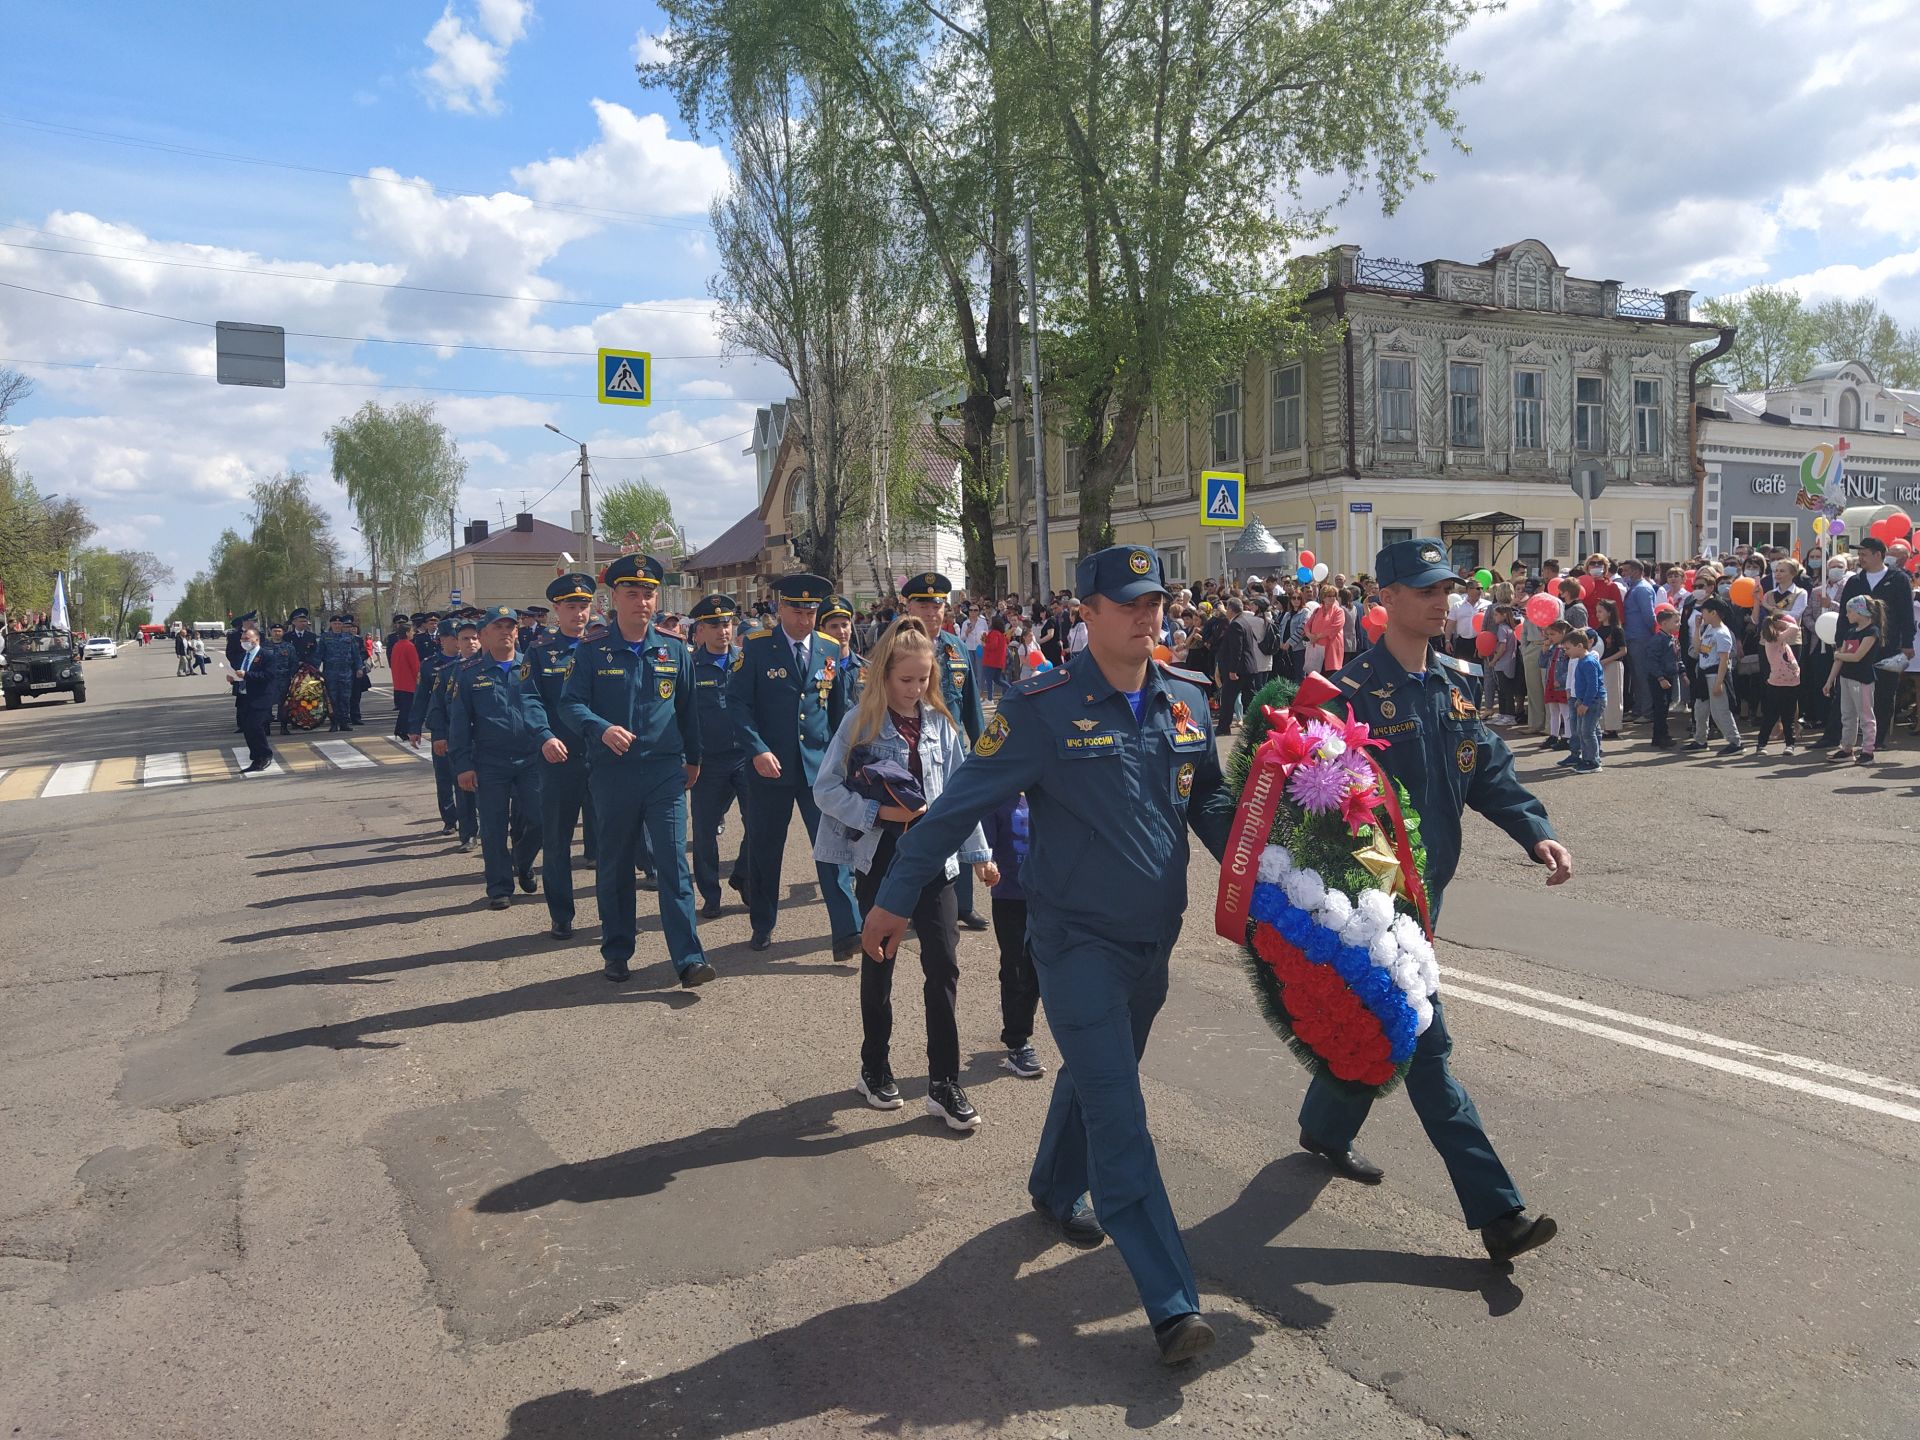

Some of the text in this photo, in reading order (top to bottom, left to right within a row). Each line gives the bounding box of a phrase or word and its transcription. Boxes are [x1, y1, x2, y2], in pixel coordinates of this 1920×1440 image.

[1755, 473, 1786, 494] café
[1066, 735, 1113, 747] МЧС РОССИИ
[1224, 882, 1241, 914] от
